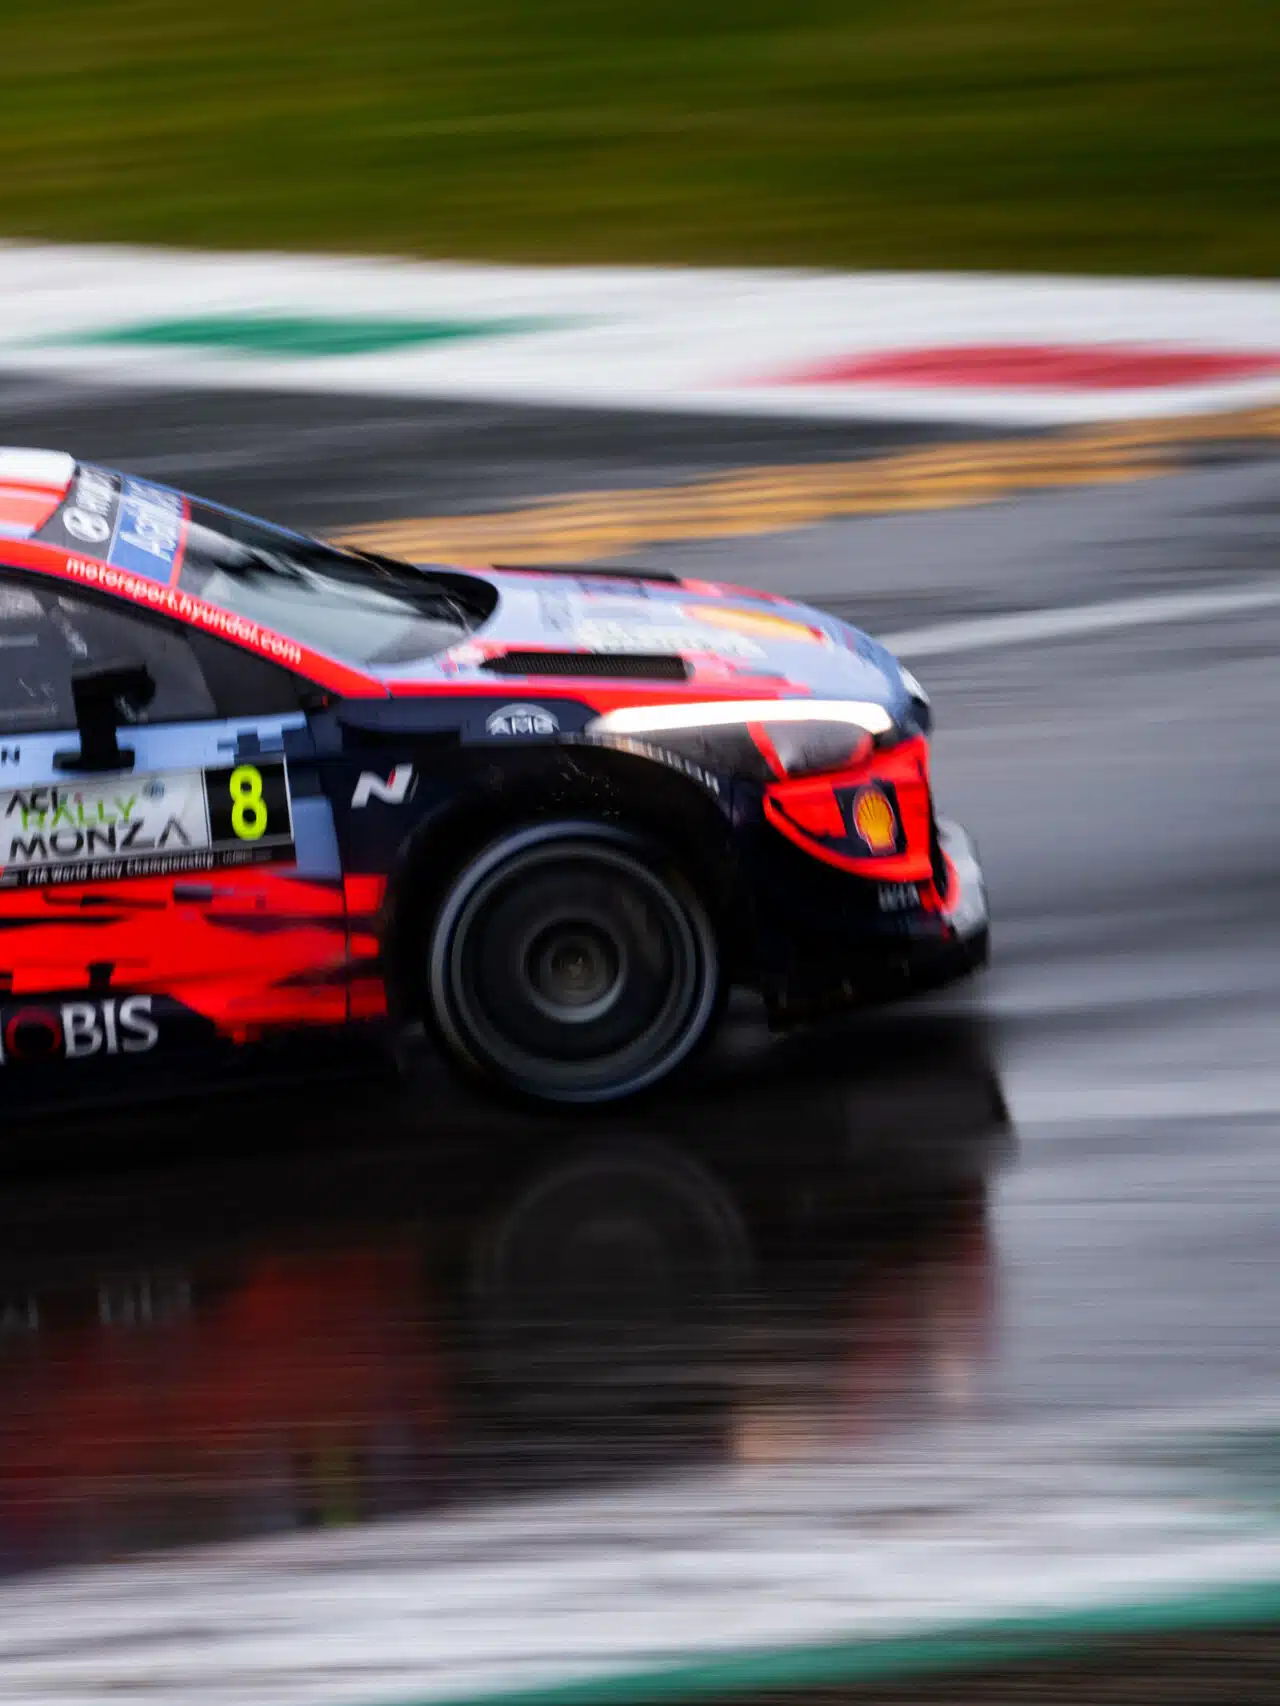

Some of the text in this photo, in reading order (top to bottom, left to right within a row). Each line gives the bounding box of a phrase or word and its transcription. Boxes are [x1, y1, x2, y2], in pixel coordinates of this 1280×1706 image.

[229, 764, 268, 840] 8
[8, 814, 191, 863] MONZA
[51, 862, 87, 884] World
